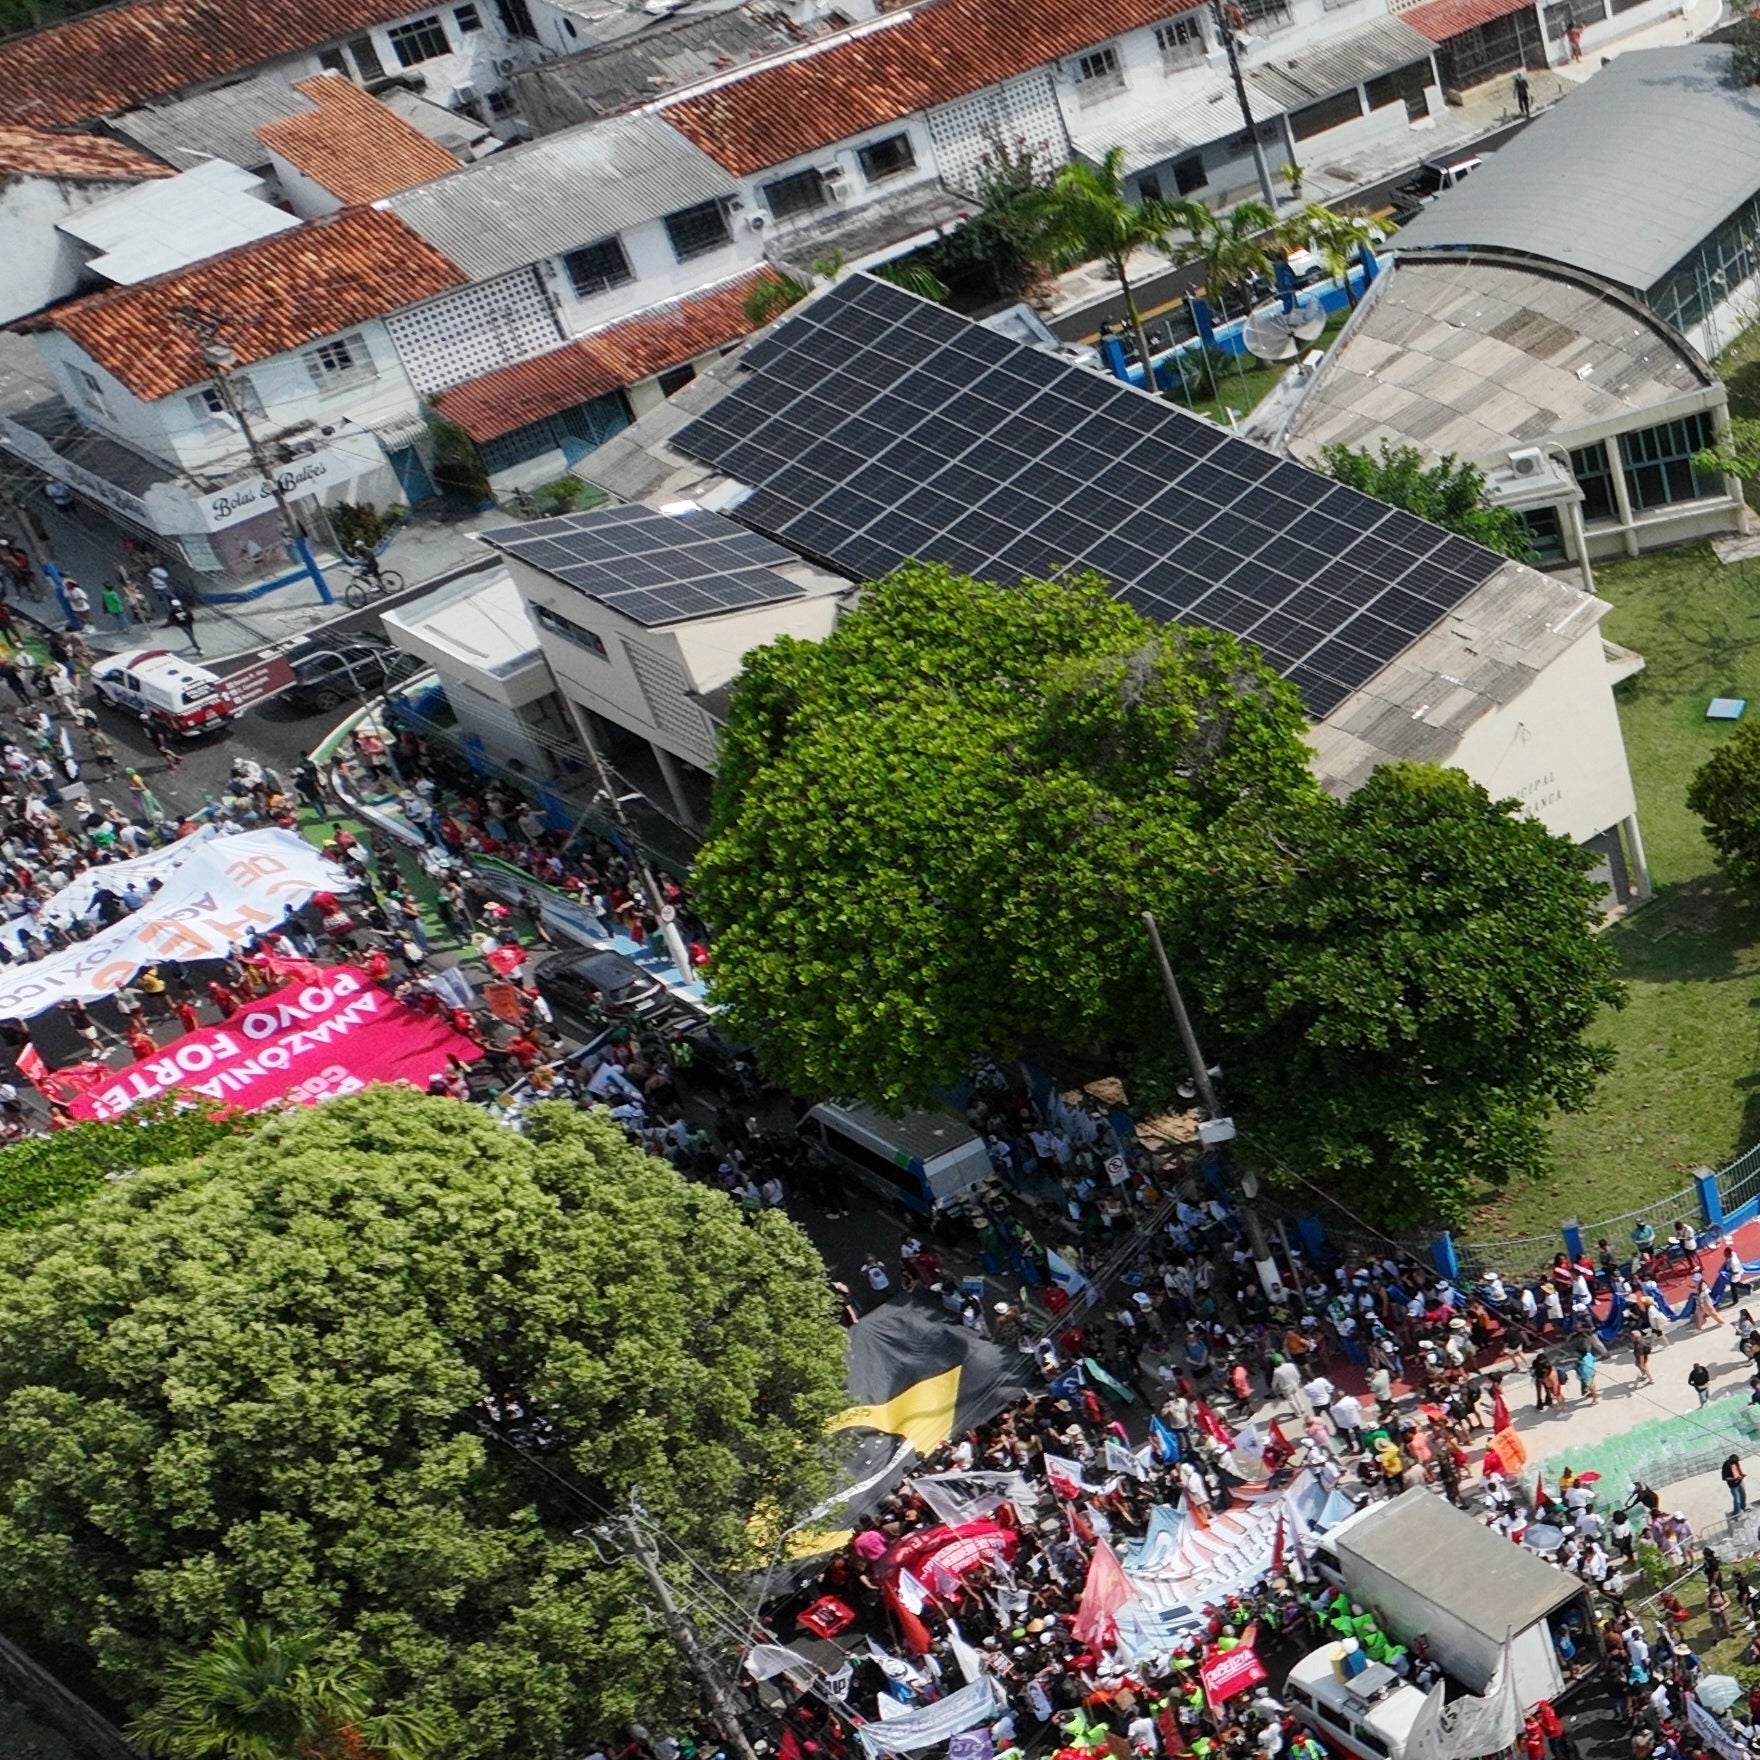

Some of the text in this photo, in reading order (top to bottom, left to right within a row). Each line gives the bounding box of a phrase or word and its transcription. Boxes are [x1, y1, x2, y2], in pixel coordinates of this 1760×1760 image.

[212, 489, 256, 520] Bolas
[259, 483, 274, 499] &
[226, 856, 288, 887] DE
[95, 973, 361, 1120] POVO FORTE!
[193, 992, 379, 1100] AMAZÔNIA
